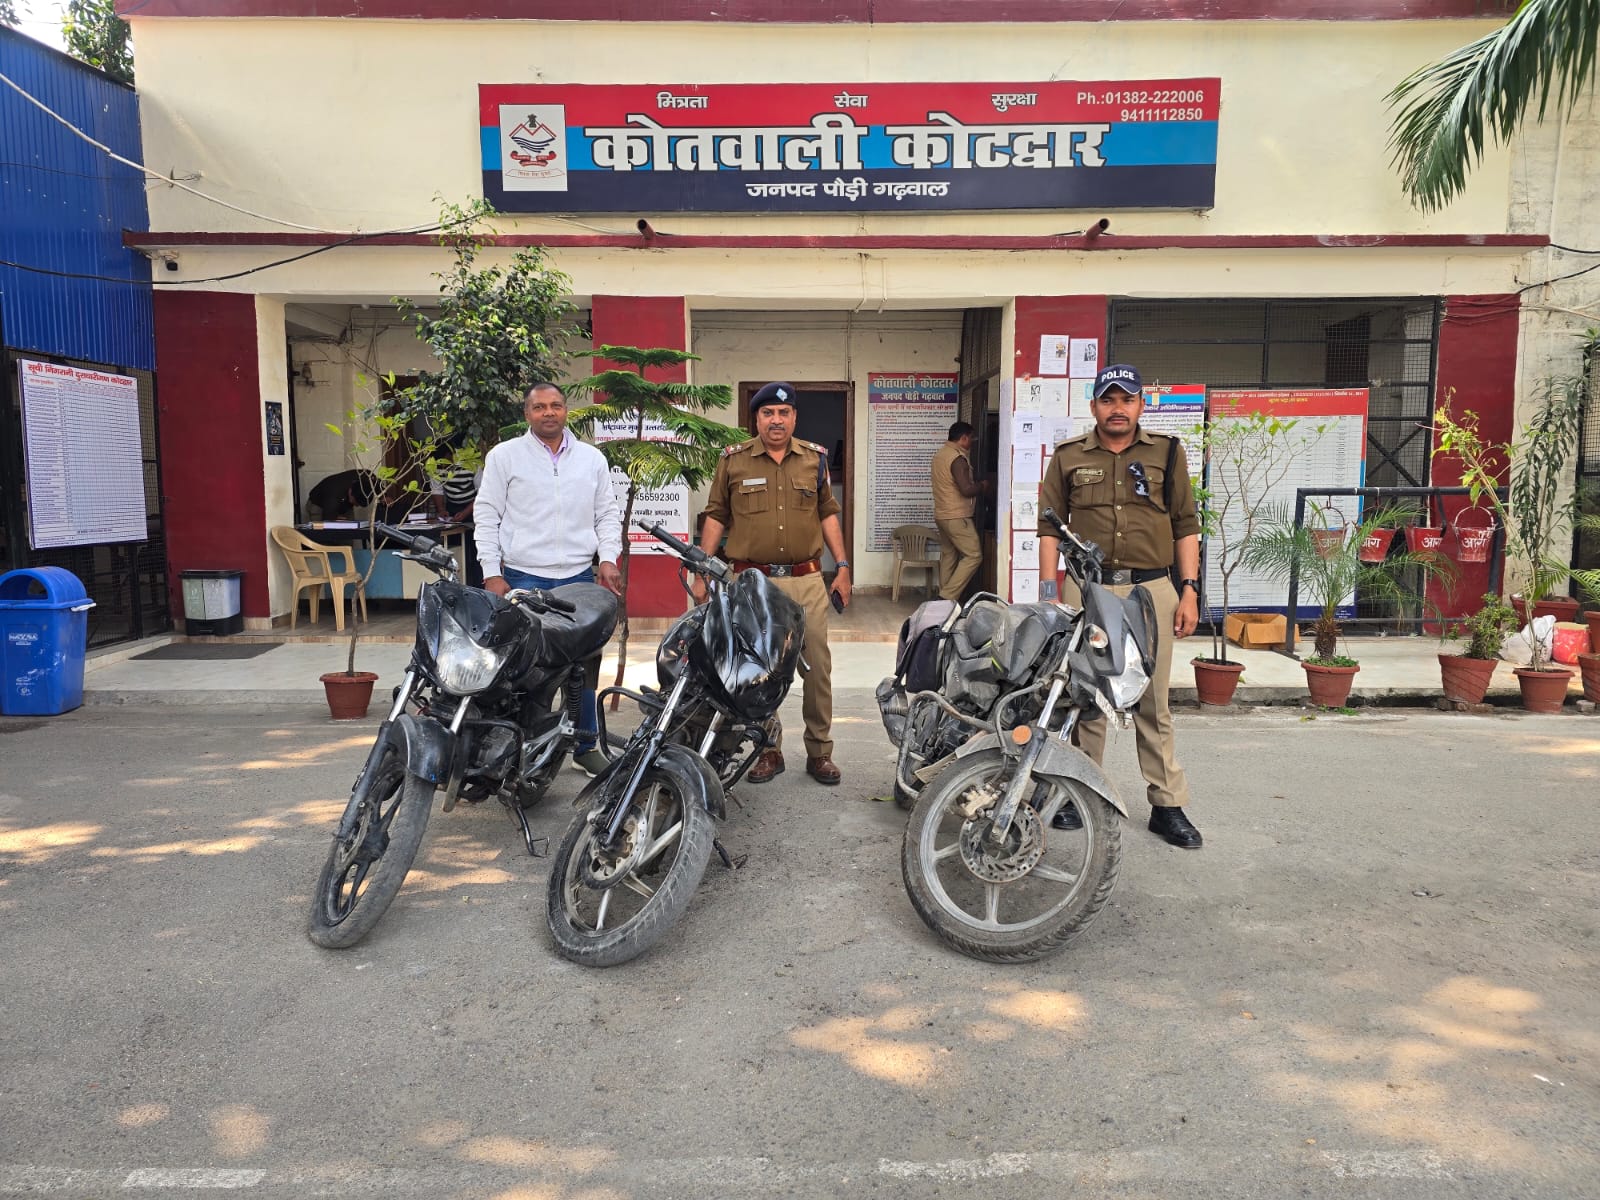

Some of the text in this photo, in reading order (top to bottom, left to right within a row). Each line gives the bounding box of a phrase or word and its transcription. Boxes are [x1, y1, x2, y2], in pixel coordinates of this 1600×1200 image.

[656, 91, 1038, 111] मित्रता सेवा सुरक्षा
[1077, 90, 1204, 106] Ph.:01382-222006
[1120, 108, 1203, 122] 9411112850
[584, 111, 1111, 171] कोतवाली कोटद्वार
[745, 177, 950, 201] जनपद पौड़ी गढ़वाल
[873, 375, 916, 389] कोतवाली
[1101, 369, 1135, 383] POLICE
